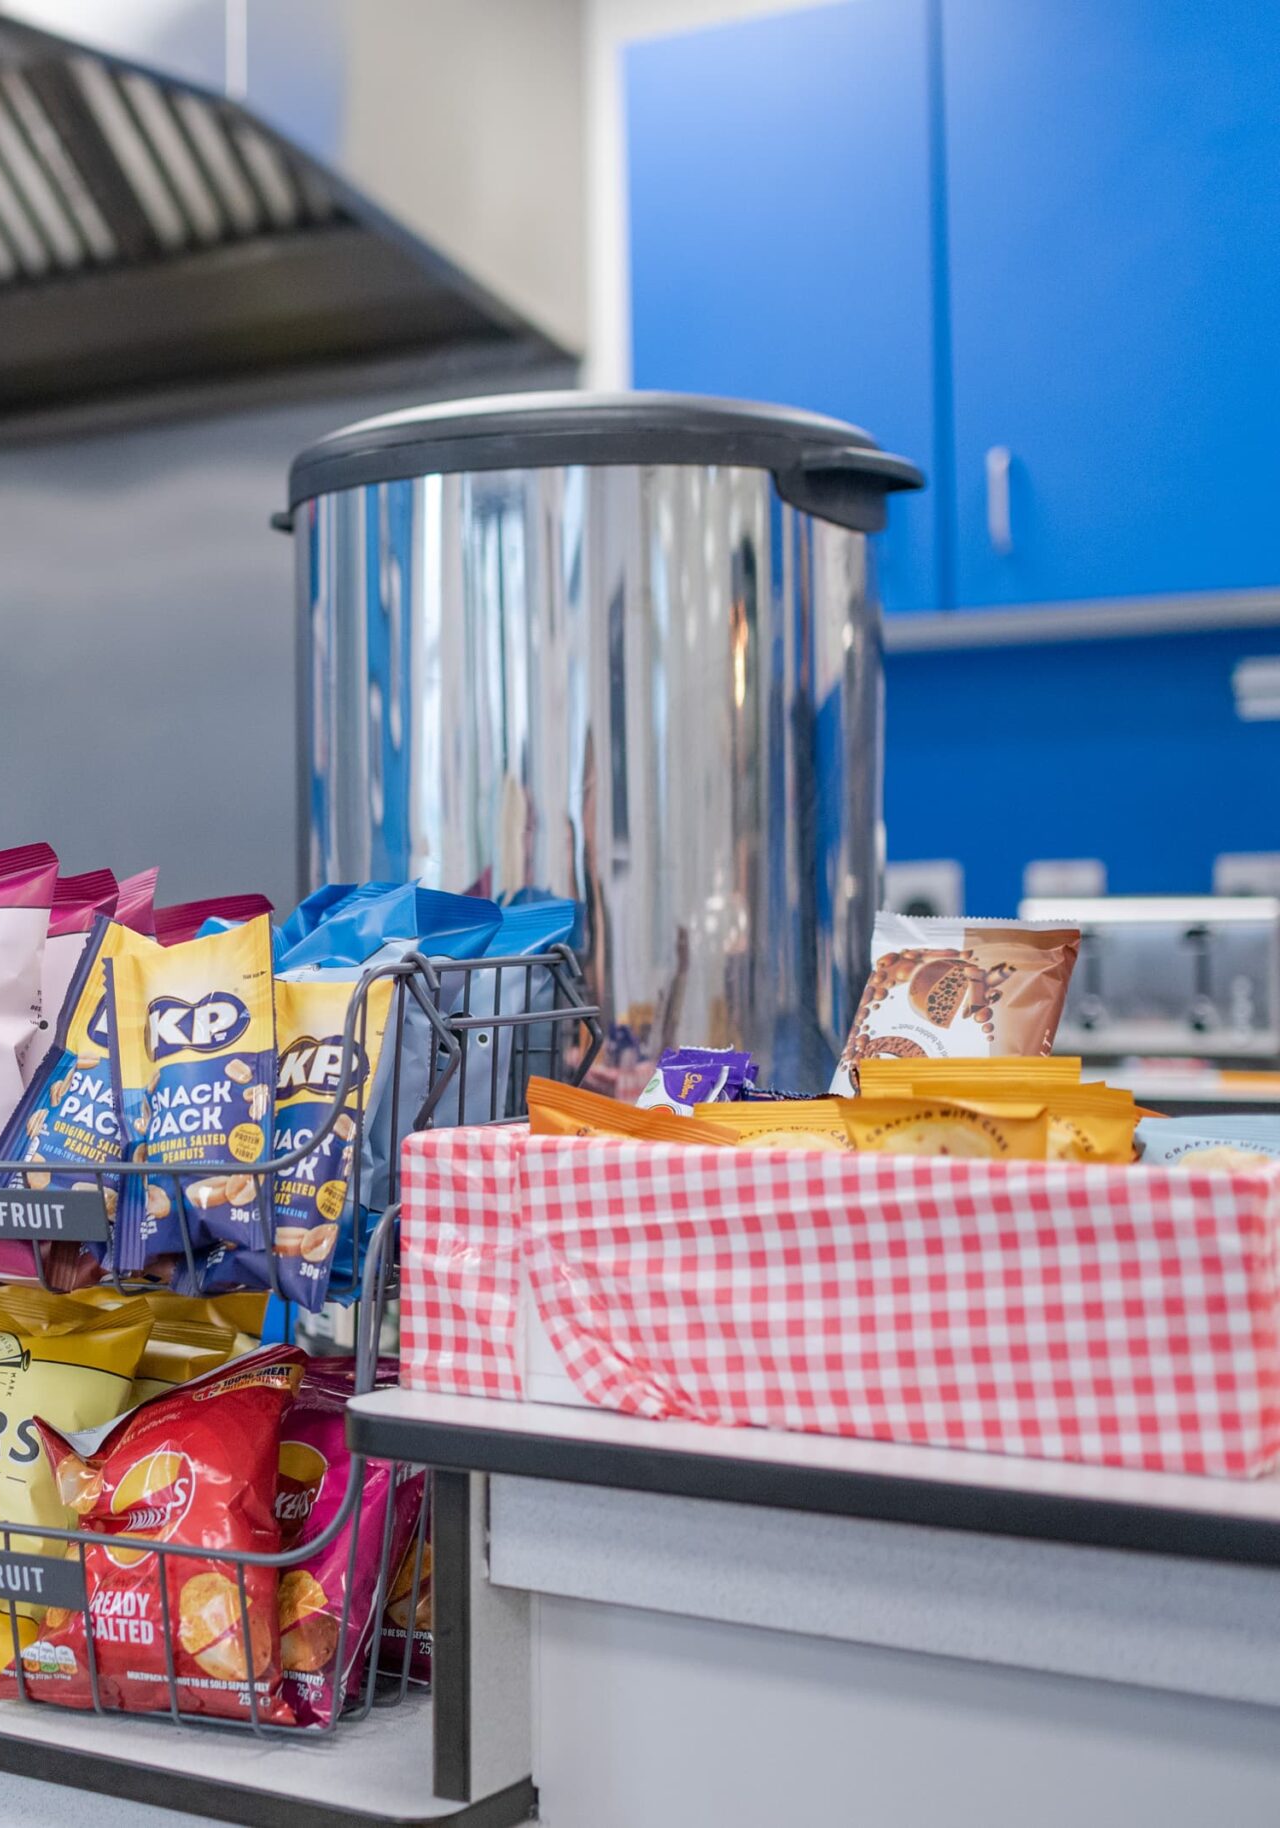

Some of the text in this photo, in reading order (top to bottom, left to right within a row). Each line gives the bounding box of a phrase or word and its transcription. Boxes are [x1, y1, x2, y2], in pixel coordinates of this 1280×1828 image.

[149, 1001, 239, 1049] KP
[278, 1045, 360, 1088] KP
[151, 1080, 233, 1116] SNACK
[60, 1095, 122, 1141] PAC
[148, 1105, 224, 1141] PACK
[939, 1109, 978, 1123] WITH
[53, 1119, 96, 1146] ORIGINAL
[190, 1132, 227, 1147] SALTED
[63, 1137, 108, 1164] PEANUTS
[162, 1146, 205, 1164] PEANUTS
[280, 1180, 317, 1198] SALTED
[230, 1207, 250, 1223] 30g
[275, 1205, 309, 1220] NACKING
[299, 1261, 319, 1280] 30g
[6, 1372, 18, 1397] MARK
[91, 1590, 151, 1618] READY
